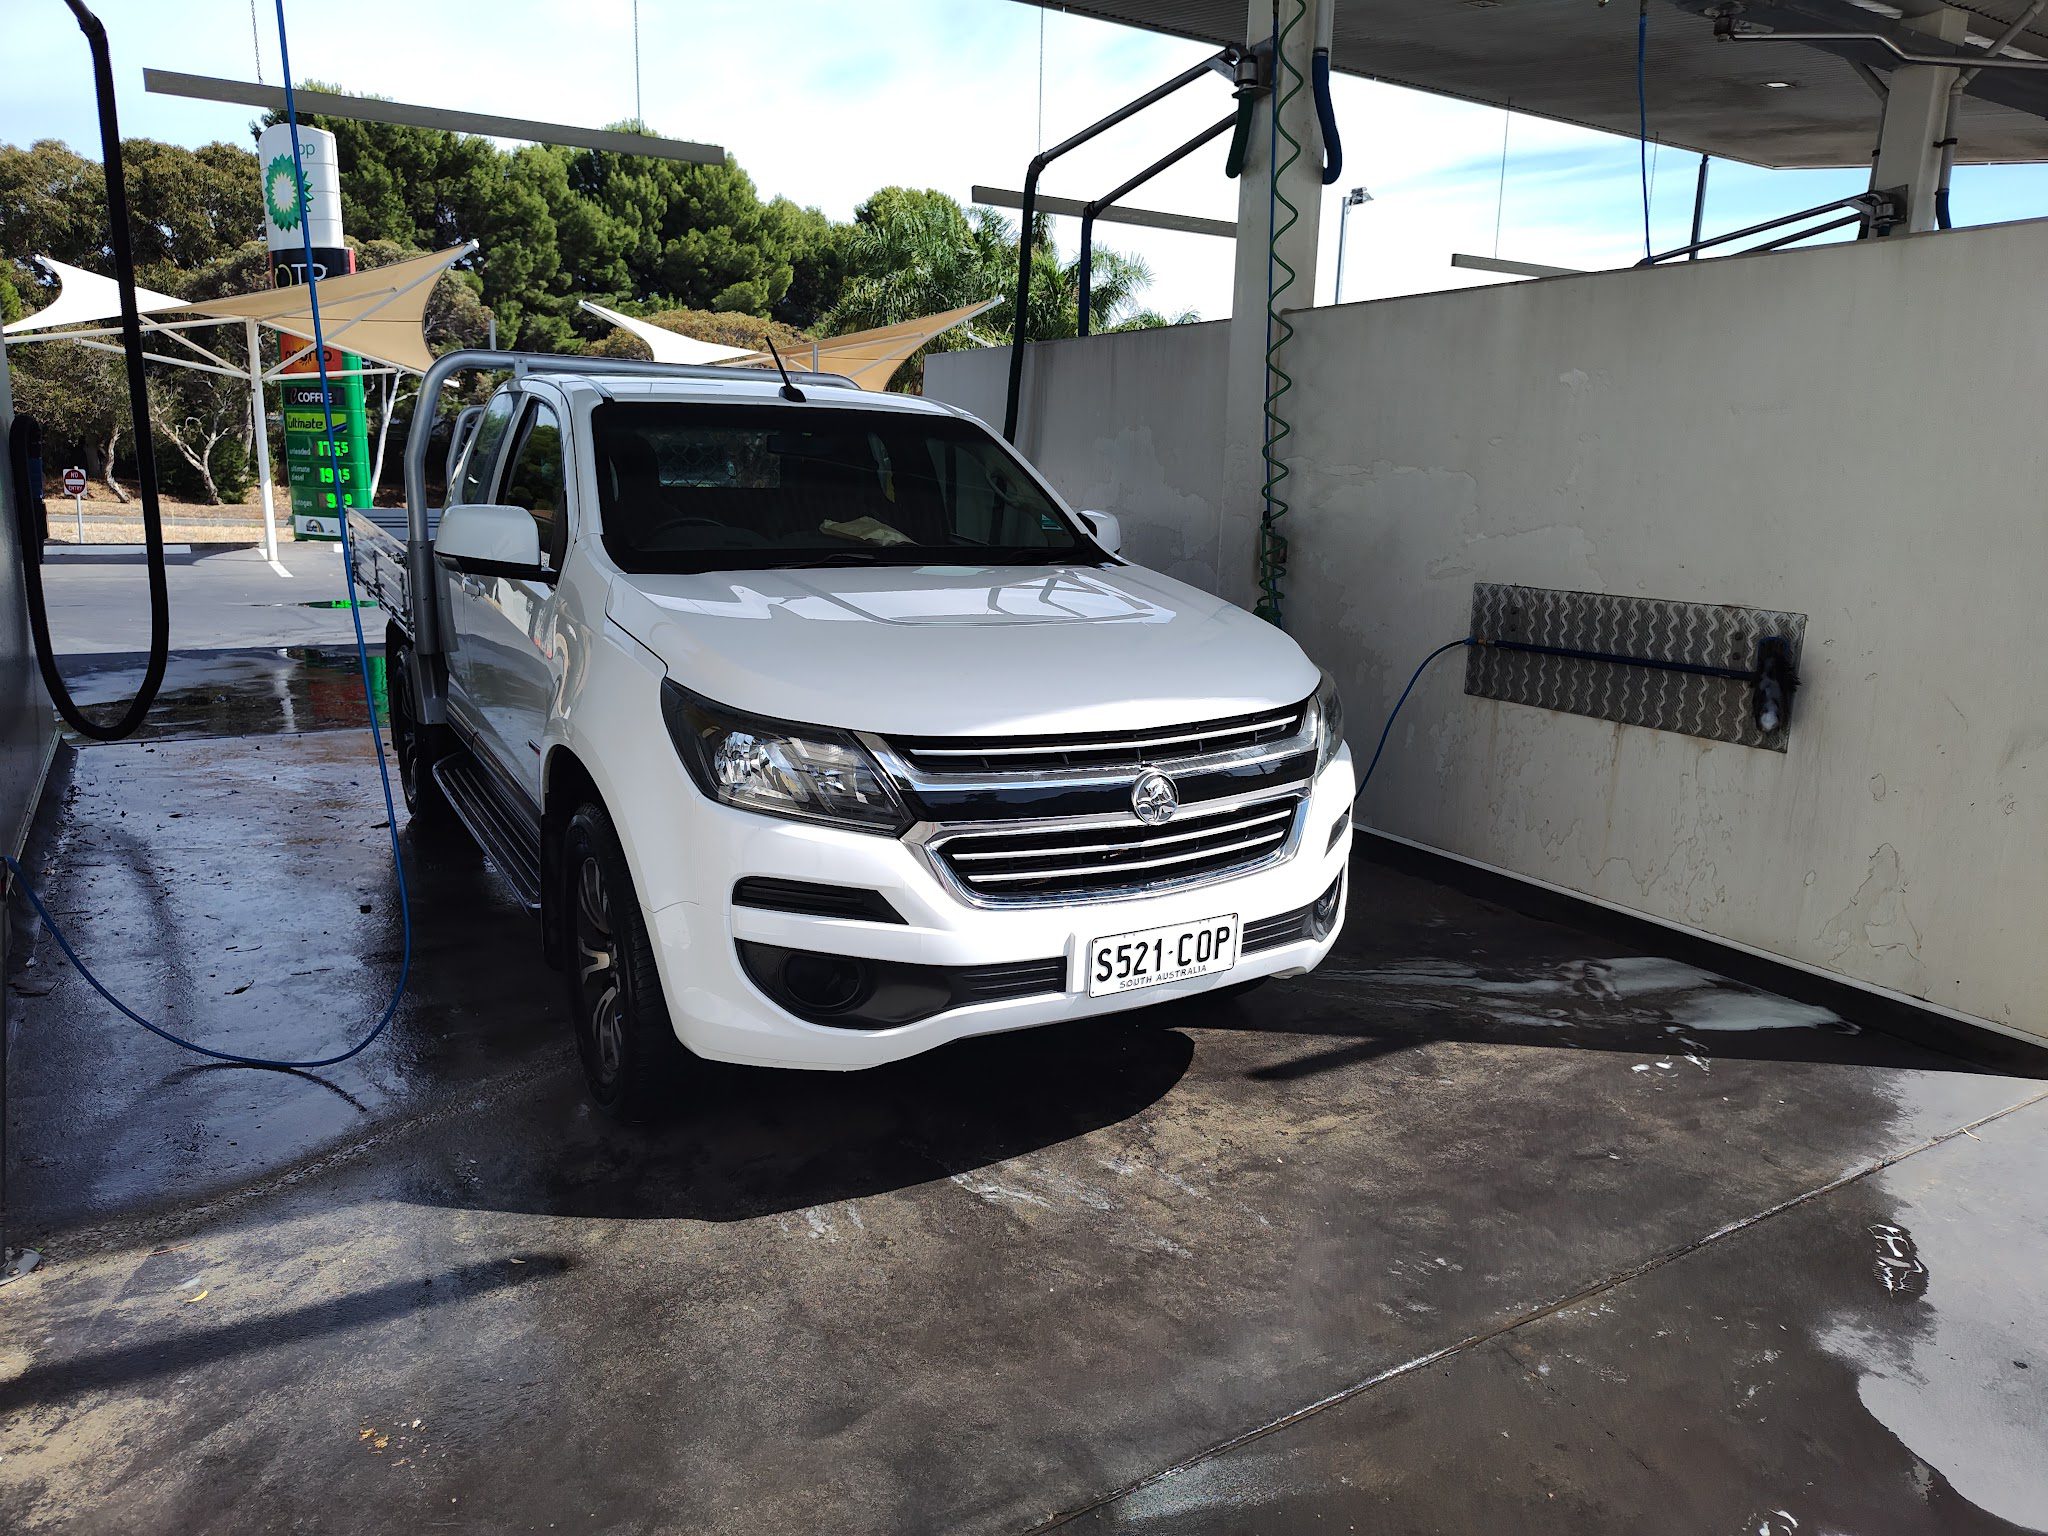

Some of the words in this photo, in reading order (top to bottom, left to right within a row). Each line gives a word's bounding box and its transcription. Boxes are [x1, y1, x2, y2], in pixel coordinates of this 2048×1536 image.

[319, 467, 351, 484] 19.5
[1119, 976, 1153, 989] SOUTH
[1155, 964, 1207, 983] AUSTRALIA
